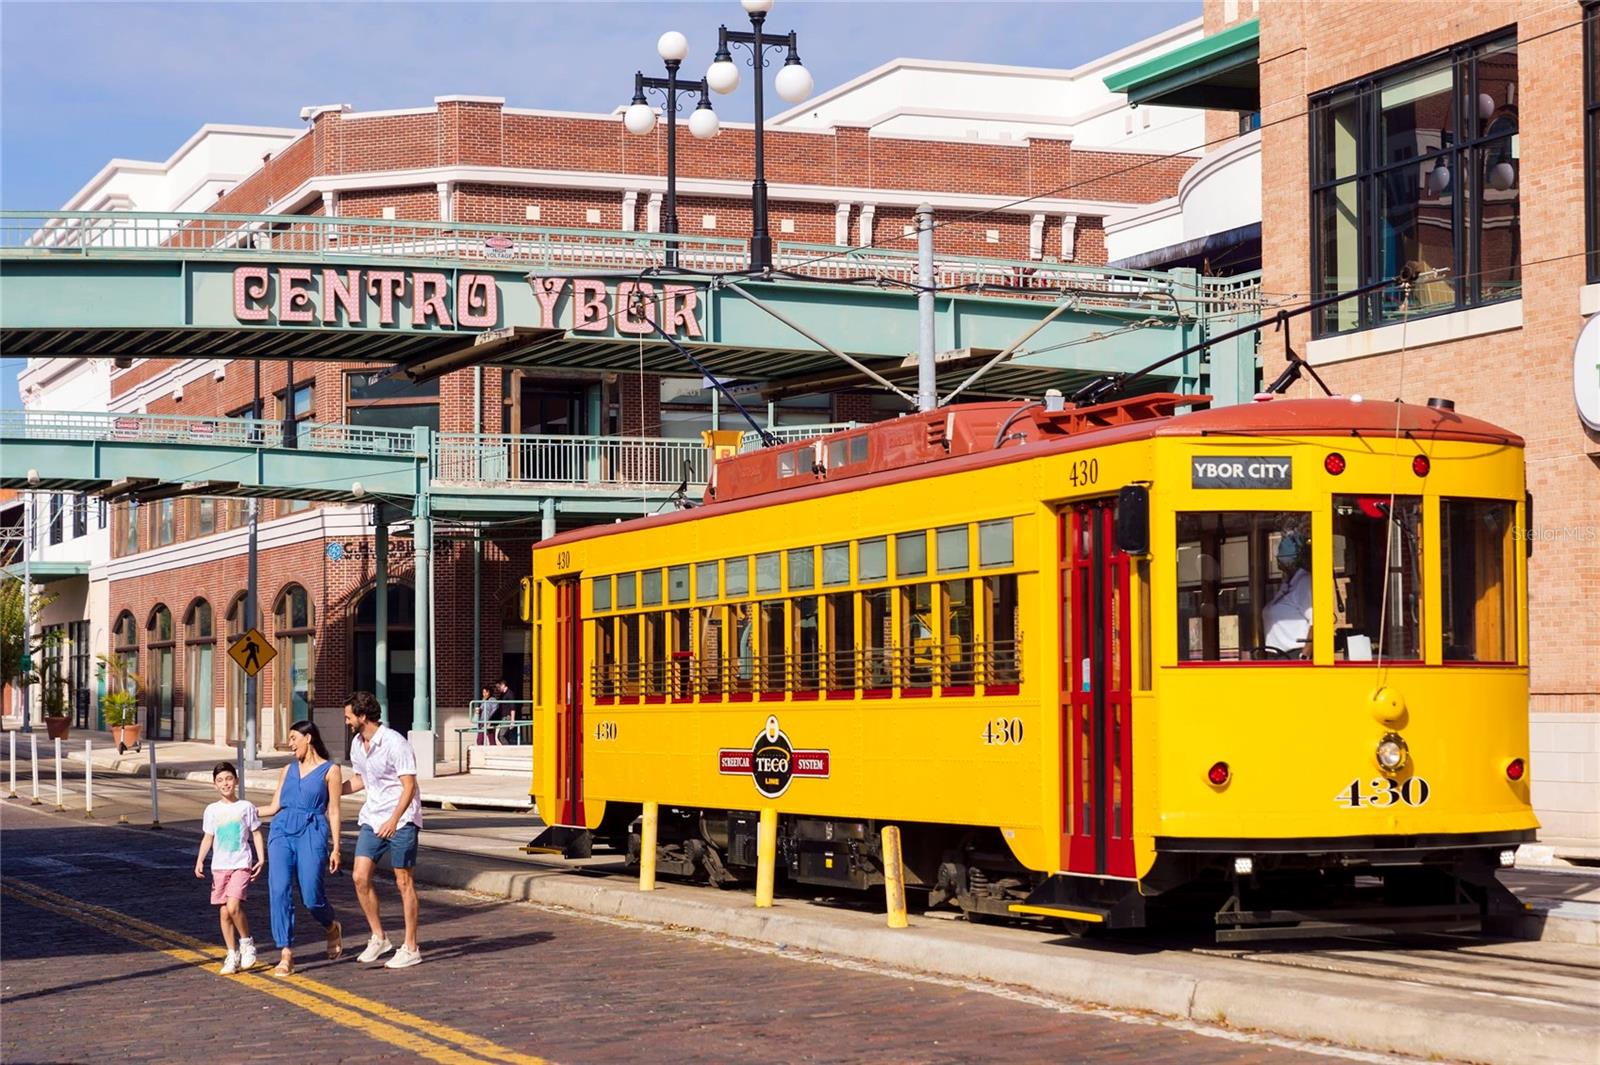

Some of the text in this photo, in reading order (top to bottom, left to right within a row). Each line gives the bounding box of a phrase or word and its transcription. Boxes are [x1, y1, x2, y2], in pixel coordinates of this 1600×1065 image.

[233, 266, 702, 337] CENTRO YBOR
[1069, 458, 1098, 487] 430
[1194, 463, 1289, 478] YBOR CITY
[556, 550, 570, 570] 430
[594, 720, 618, 741] 430
[981, 717, 1024, 745] 430
[721, 757, 750, 767] STREETCAR
[756, 758, 789, 773] TECO
[798, 759, 824, 770] SYSTEM
[1333, 776, 1430, 808] 430
